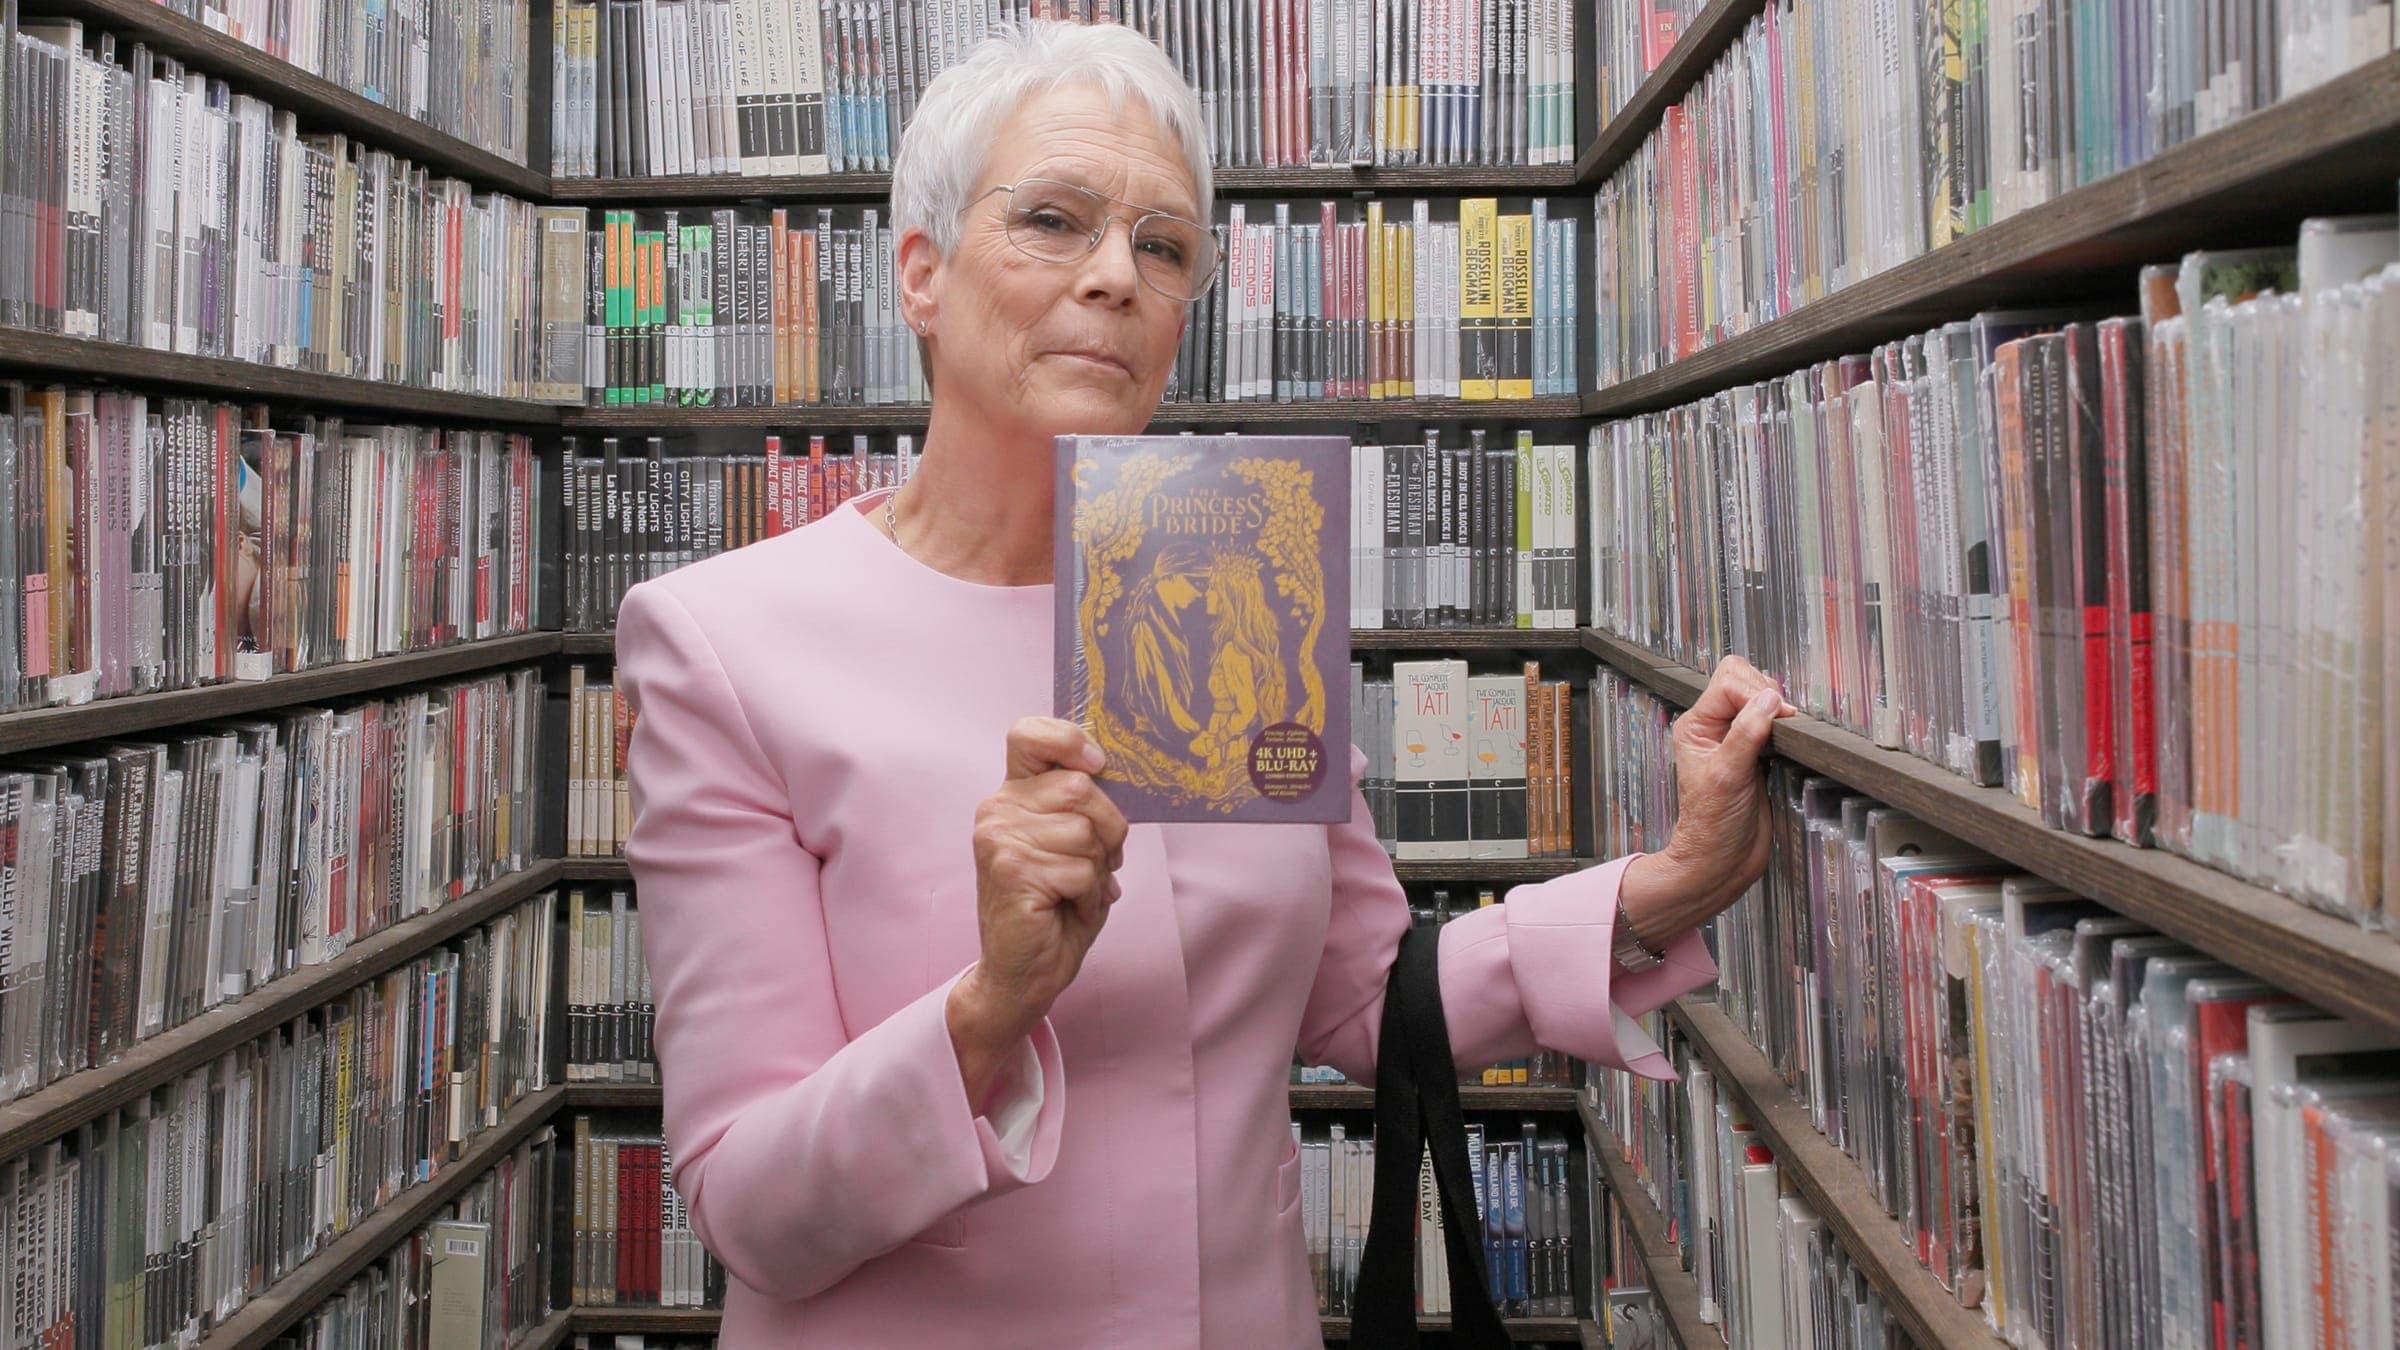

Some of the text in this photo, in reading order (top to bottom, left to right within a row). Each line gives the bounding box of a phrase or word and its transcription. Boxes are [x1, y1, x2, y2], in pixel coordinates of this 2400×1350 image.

[927, 0, 939, 41] URPLE
[944, 0, 954, 48] PURPLE
[1660, 23, 1672, 31] IN
[738, 41, 746, 56] OF
[768, 46, 776, 59] OF
[798, 46, 806, 58] OF
[740, 60, 749, 86] LIFE
[769, 63, 778, 85] LIFE
[800, 62, 808, 84] LIFE
[102, 52, 112, 166] UMBERTO D.
[667, 220, 678, 268] REPO MAN
[865, 220, 875, 289] medium cool
[1232, 218, 1242, 288] SECONDS
[717, 222, 729, 315] PIERRE ETAIX
[737, 229, 748, 320] PIERRE ETAIX
[756, 229, 768, 320] PIERRE ETAIX
[819, 250, 831, 282] YUMA
[835, 271, 846, 302] YUMA
[850, 271, 862, 302] YUMA
[881, 241, 890, 310] medium cool
[1246, 238, 1256, 308] SECONDS
[1466, 248, 1477, 305] BERGMAN
[1479, 241, 1491, 305] ROSSELLINI
[1502, 257, 1515, 314] BERGMAN
[1515, 250, 1528, 313] ROSSELLINI
[2032, 365, 2044, 459] CITIZEN KANE
[1427, 440, 1436, 458] RIOT
[1427, 460, 1436, 469] IN
[1442, 458, 1451, 477] RIOT
[563, 450, 573, 506] THE UNINVITED
[768, 449, 778, 512] TOUKI BOUKI
[1427, 471, 1436, 488] CELL
[1442, 479, 1451, 488] IN
[1459, 462, 1468, 480] RIOT
[1459, 483, 1468, 492] IN
[608, 474, 617, 519] La Notte
[623, 491, 632, 533] La Notte
[638, 491, 647, 533] La Notte
[650, 461, 659, 532] CITY LIGHTS
[663, 472, 673, 543] CITY LIGHTS
[680, 470, 690, 542] CITY LIGHTS
[782, 466, 792, 528] TOUKI BOUKI
[798, 464, 807, 526] TOUKI BOUKI
[1151, 493, 1262, 528] PRINCESS
[1190, 488, 1218, 496] THE
[1408, 477, 1422, 535] FRESHMAN
[1427, 489, 1436, 513] BLOCK
[1442, 489, 1451, 506] CELL
[1459, 493, 1468, 510] CELL
[693, 483, 706, 549] Frances Ha
[708, 480, 722, 546] Frances Ha
[1166, 516, 1241, 534] BRIDE
[1442, 508, 1451, 532] BLOCK
[1459, 512, 1468, 536] BLOCK
[1420, 673, 1448, 682] COMPLETE
[1488, 688, 1516, 698] COMPLETE
[1412, 683, 1449, 716] TATI
[1480, 698, 1517, 730] TATI
[1256, 747, 1273, 759] 4K
[1277, 747, 1306, 759] UHD
[1256, 760, 1318, 772] BLU-RAY
[8, 788, 22, 820] THE
[128, 766, 144, 884] MR. ARKADIN
[3, 870, 17, 920] SLEEP
[0, 926, 14, 975] WELL
[1489, 1153, 1499, 1210] MULHOLLAND DR.
[1508, 1152, 1518, 1209] MULHOLLAND DR.
[662, 1191, 672, 1230] SIEGE
[1422, 1201, 1431, 1222] DAY
[15, 1170, 26, 1339] BRUTE FORCE
[27, 1274, 35, 1340] FORCE
